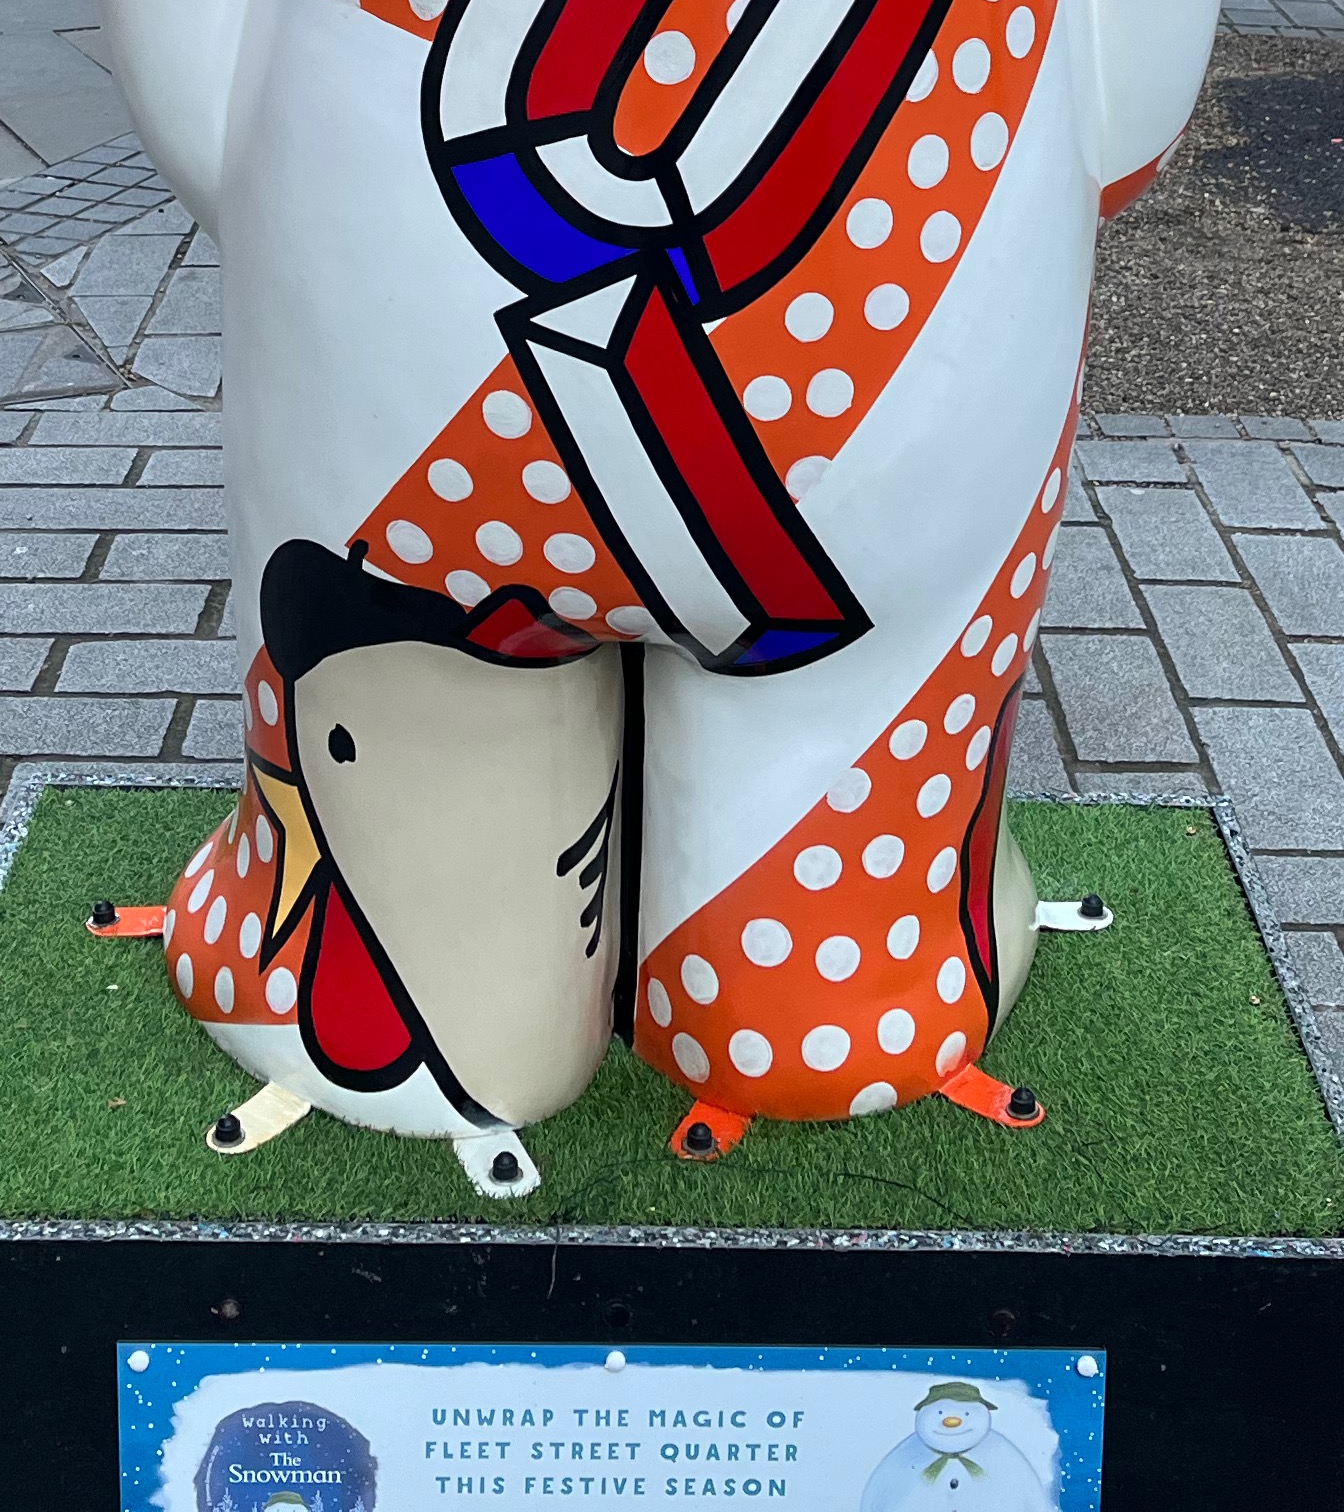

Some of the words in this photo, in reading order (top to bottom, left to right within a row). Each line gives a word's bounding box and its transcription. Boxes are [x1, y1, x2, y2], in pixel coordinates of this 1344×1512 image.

[432, 1408, 554, 1427] UNWRAP
[573, 1409, 630, 1428] THE
[649, 1409, 747, 1429] MAGIC
[766, 1410, 805, 1429] OF
[258, 1431, 309, 1445] with
[269, 1452, 302, 1467] The
[425, 1441, 511, 1460] FLEET
[531, 1442, 641, 1460] STREET
[660, 1443, 798, 1463] QUARTER
[229, 1463, 342, 1484] Snowman
[435, 1476, 505, 1495] THIS
[525, 1476, 646, 1496] FESTIVE
[665, 1478, 787, 1497] SEASON
